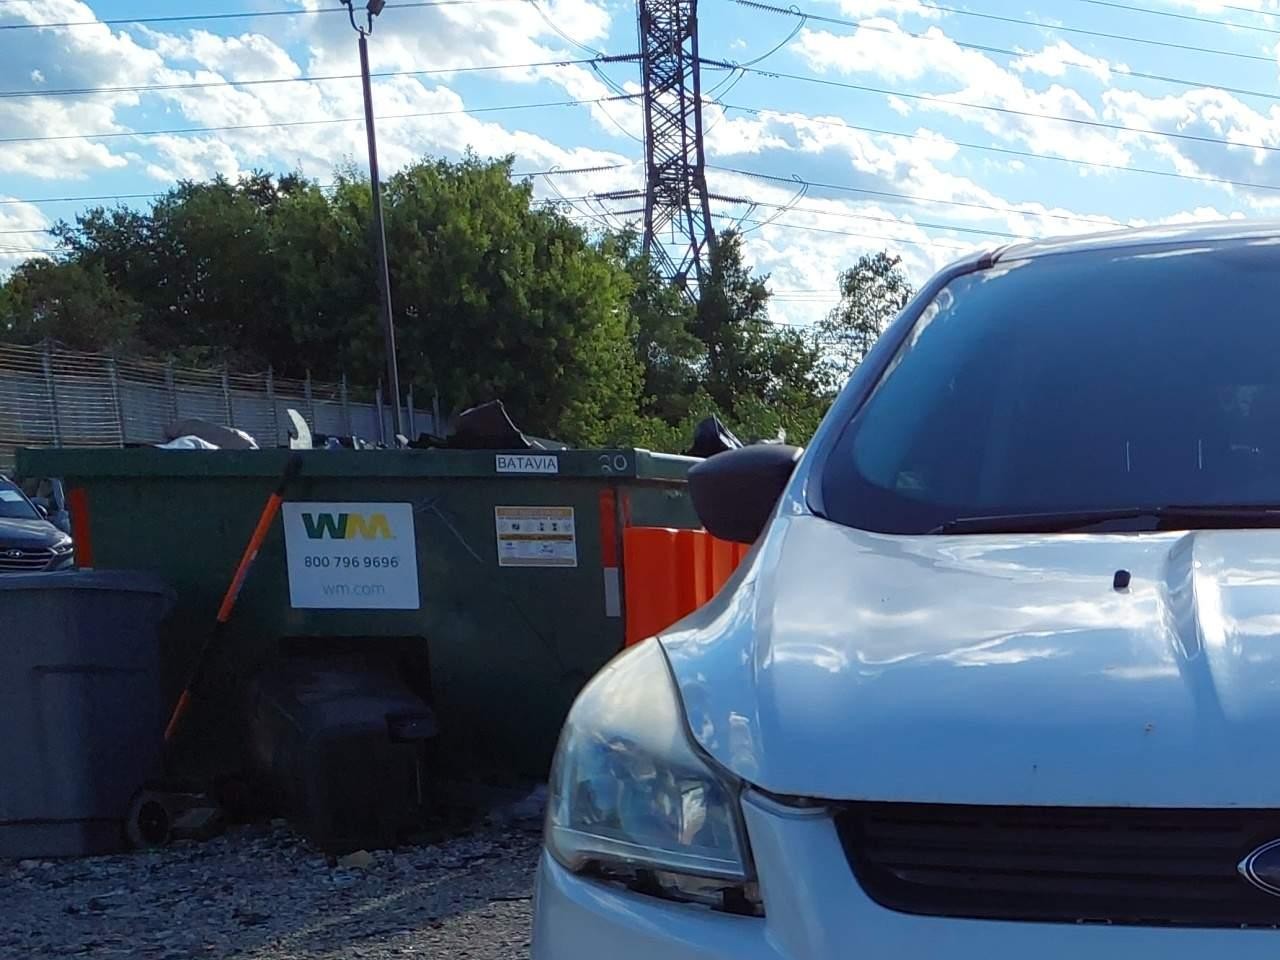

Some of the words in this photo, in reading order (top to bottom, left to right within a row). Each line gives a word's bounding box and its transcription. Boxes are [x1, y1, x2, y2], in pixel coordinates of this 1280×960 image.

[497, 456, 558, 470] BATAVIA
[301, 513, 391, 540] WM
[304, 556, 330, 568] 800
[334, 556, 360, 568] 796
[363, 556, 399, 568] 9696
[322, 583, 385, 596] wm.com
